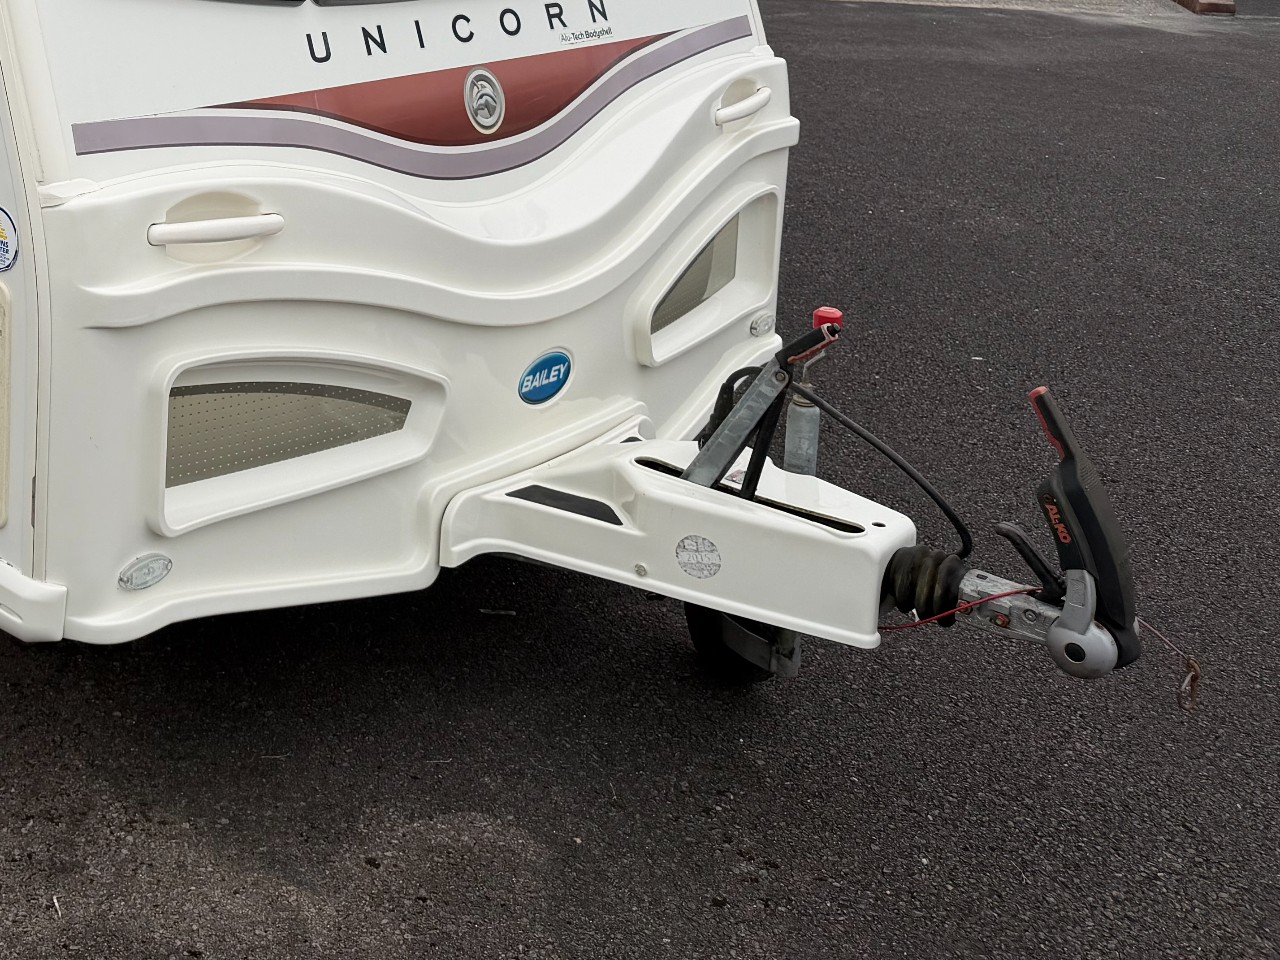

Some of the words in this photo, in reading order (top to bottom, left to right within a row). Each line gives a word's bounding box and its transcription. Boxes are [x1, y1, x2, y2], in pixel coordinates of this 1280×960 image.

[561, 32, 585, 42] Alu-Tech
[585, 27, 613, 39] Bodyshell
[521, 362, 568, 393] BAILEY
[687, 553, 711, 563] 2015
